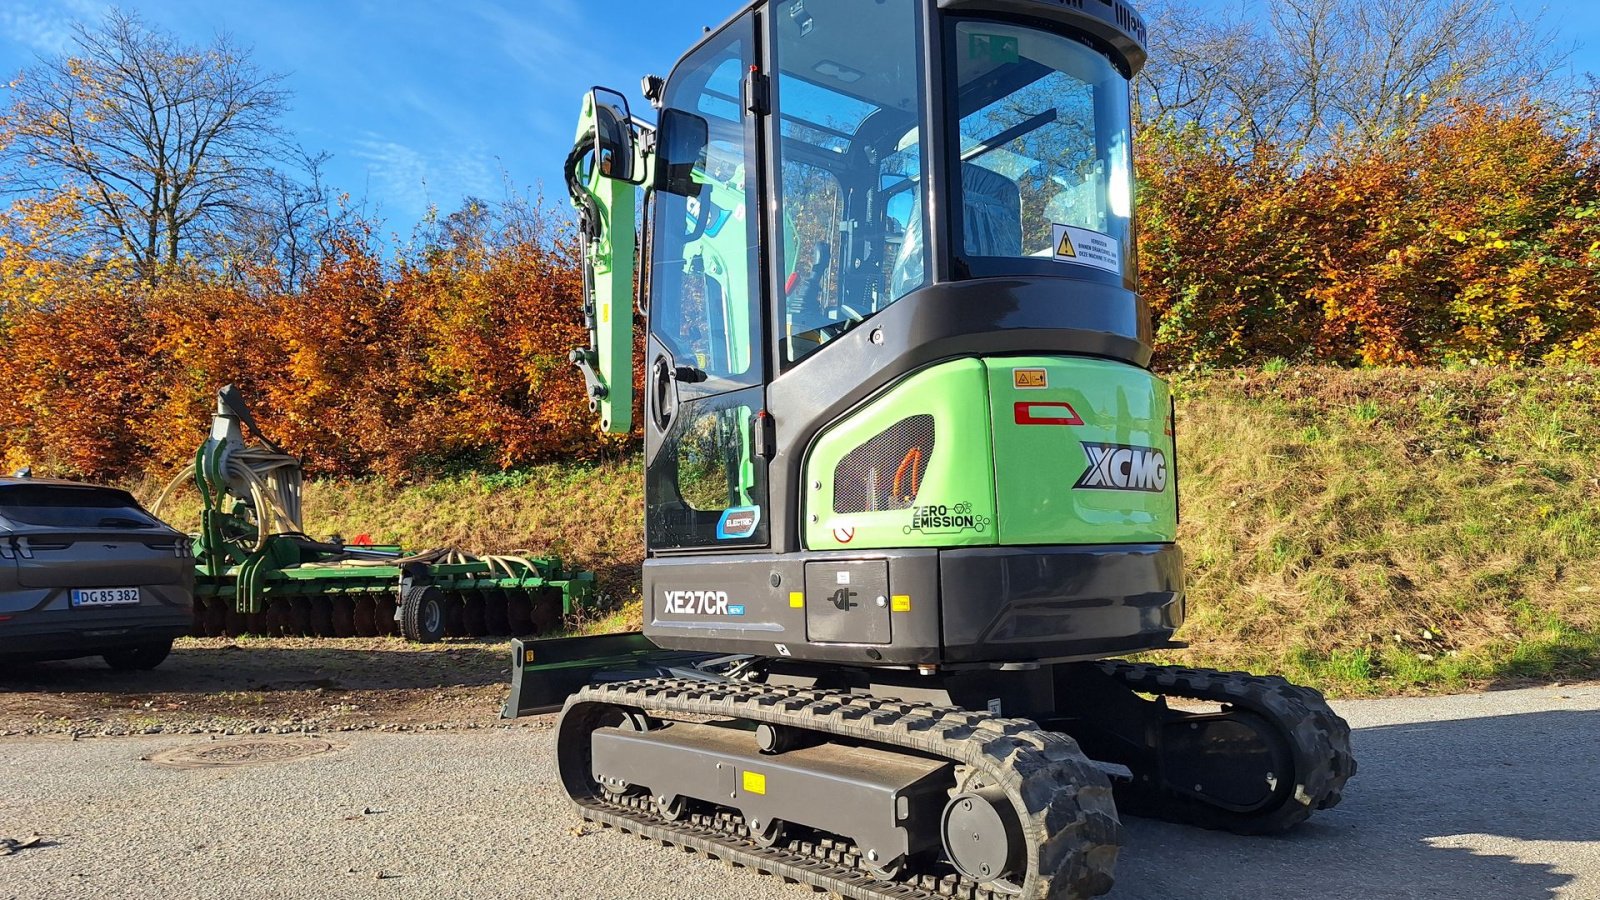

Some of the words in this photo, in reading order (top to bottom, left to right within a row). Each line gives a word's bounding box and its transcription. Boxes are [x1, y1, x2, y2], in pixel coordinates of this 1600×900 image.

[1079, 446, 1166, 491] XCMG
[913, 505, 947, 517] ZERO
[726, 518, 753, 527] ELECTRIC
[912, 515, 974, 528] EMISSION
[81, 591, 98, 603] DG
[100, 590, 114, 602] 85
[117, 589, 138, 601] 382
[664, 591, 728, 614] XE27CR
